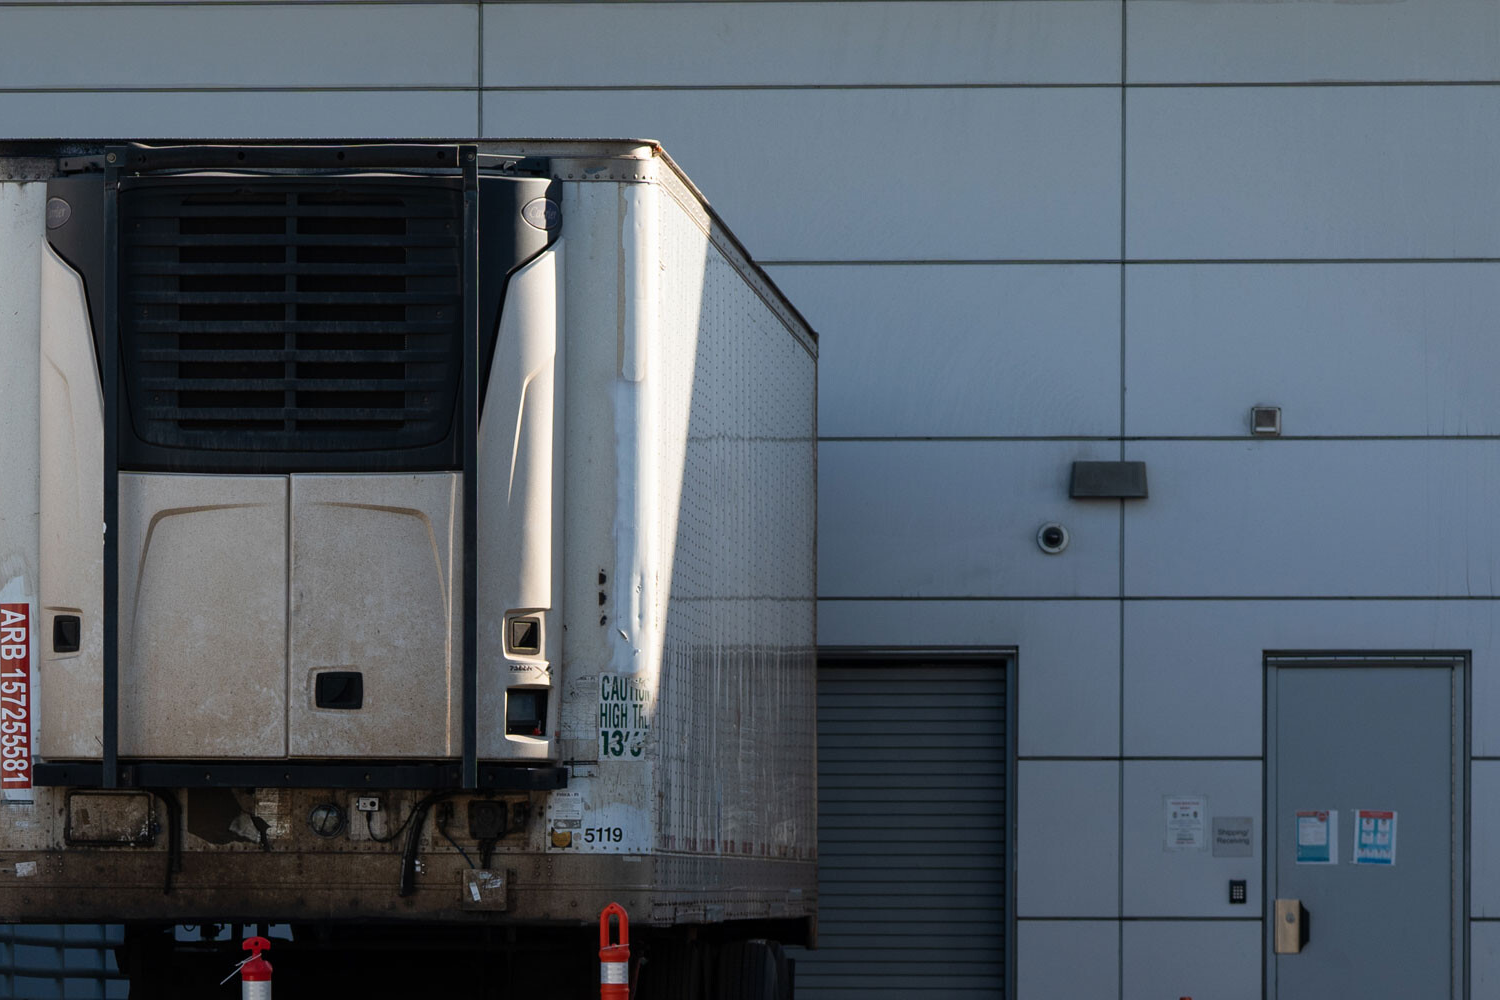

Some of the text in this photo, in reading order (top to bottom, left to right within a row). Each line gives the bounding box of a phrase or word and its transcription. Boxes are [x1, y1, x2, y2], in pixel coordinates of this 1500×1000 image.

[0, 609, 28, 783] ARB 157255581
[599, 703, 628, 729] HIGH
[584, 827, 623, 843] 5119
[1216, 837, 1250, 846] Receiving
